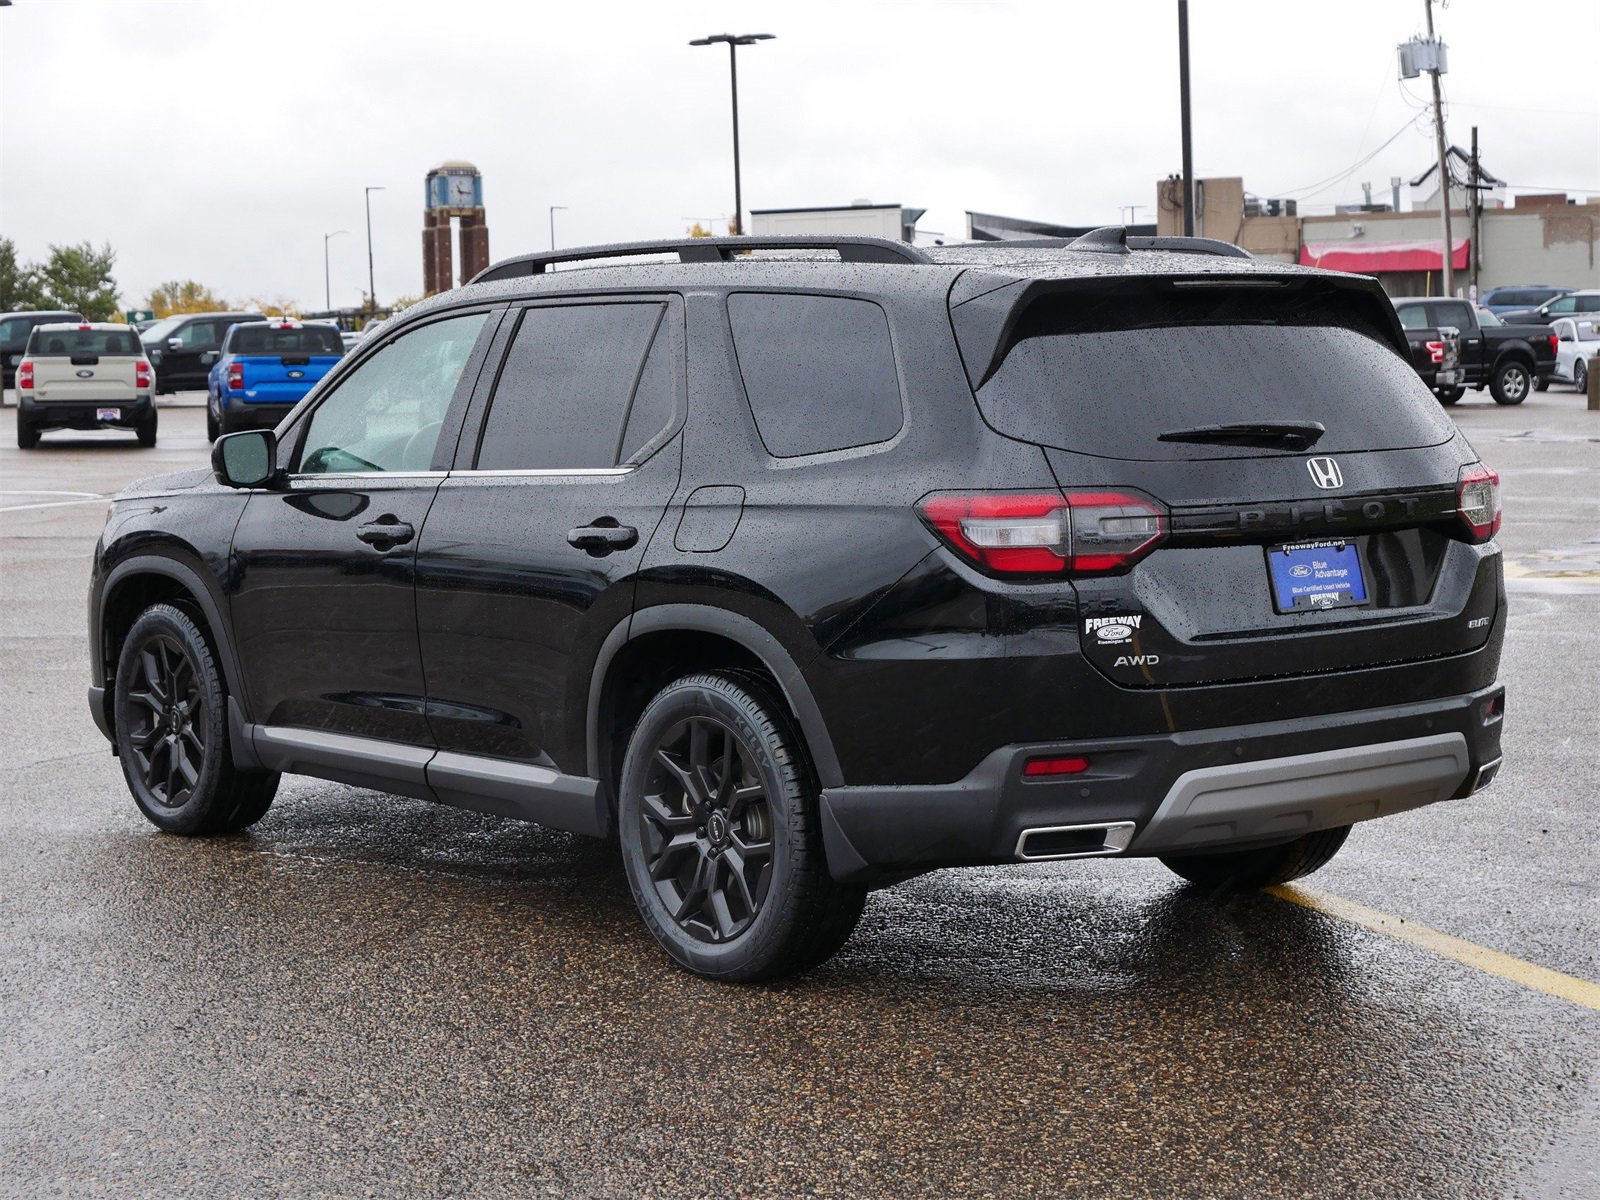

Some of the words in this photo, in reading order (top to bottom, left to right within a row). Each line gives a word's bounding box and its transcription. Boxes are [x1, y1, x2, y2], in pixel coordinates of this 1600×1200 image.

[1239, 498, 1419, 527] PILOT
[1282, 540, 1346, 550] FreewayFord.net
[1312, 561, 1327, 569] Blue
[1315, 569, 1348, 578] Advantage
[1310, 592, 1339, 605] FREEWAY
[1085, 615, 1142, 634] FREEWAY
[1113, 655, 1160, 667] AWD
[734, 716, 770, 767] KELLY
